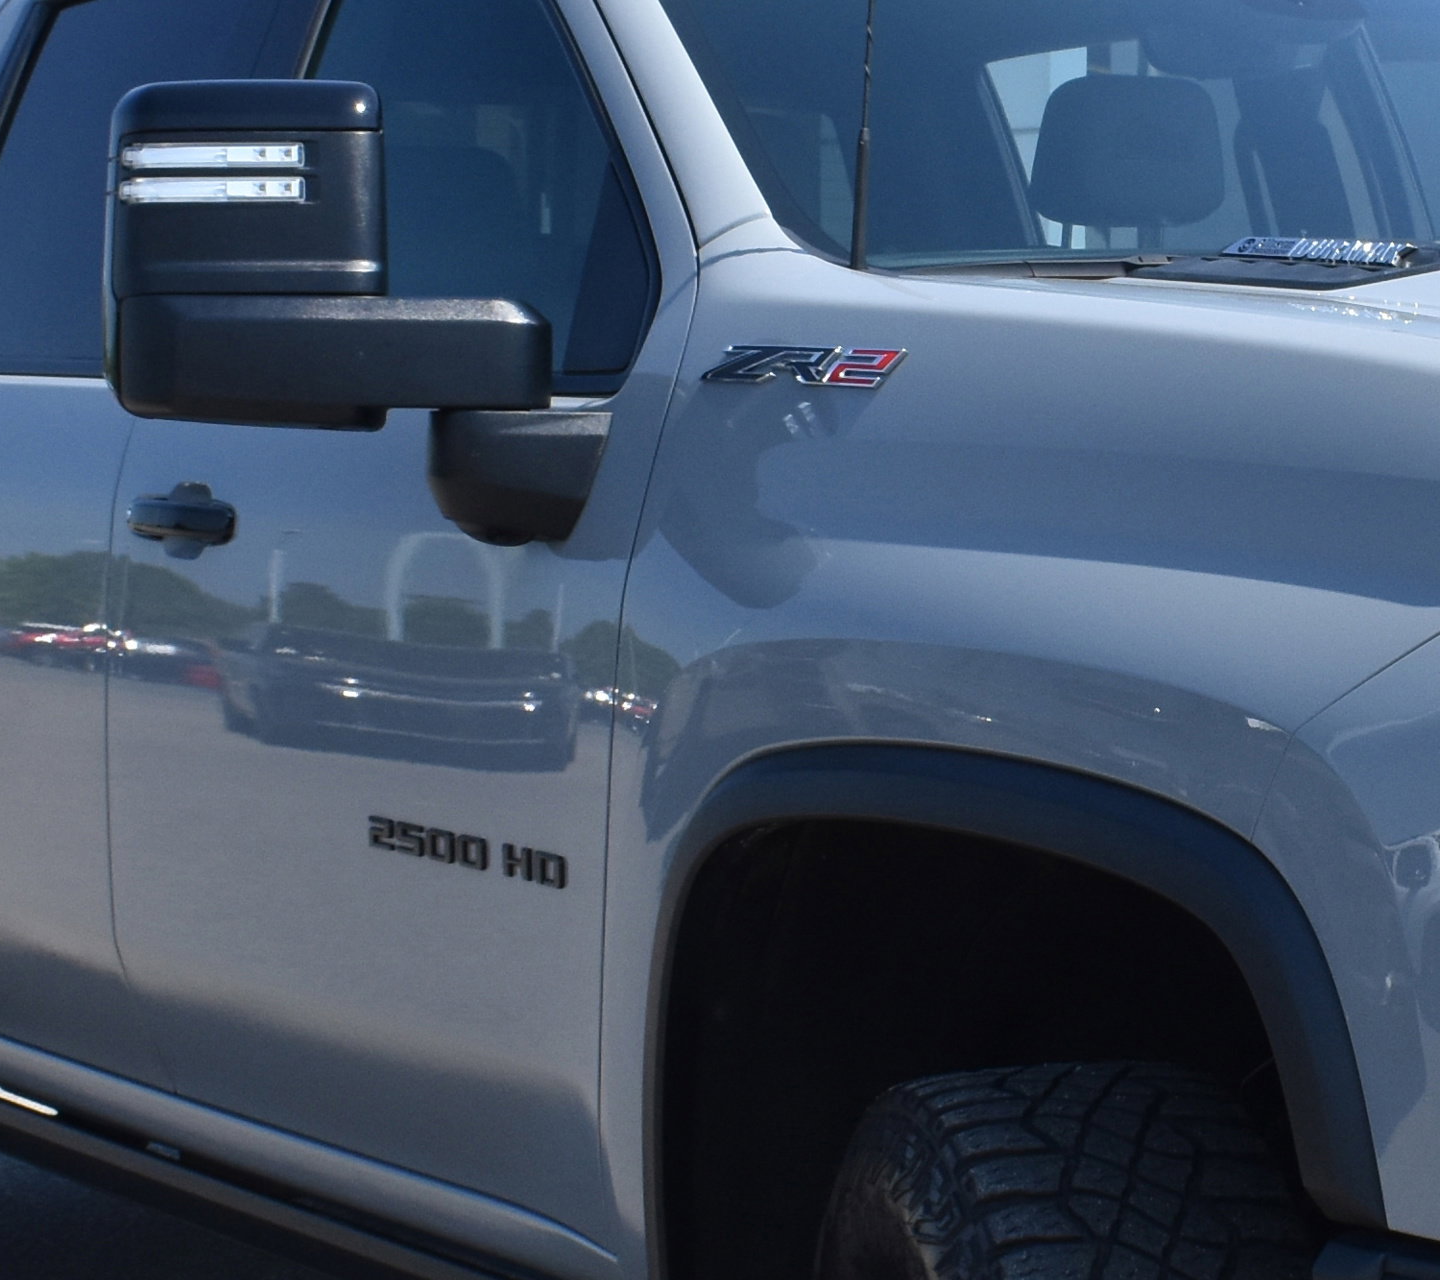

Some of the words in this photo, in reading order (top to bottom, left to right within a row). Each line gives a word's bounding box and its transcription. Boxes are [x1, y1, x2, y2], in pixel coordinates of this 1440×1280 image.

[700, 345, 908, 390] ZR2
[368, 815, 489, 871] 2500
[501, 842, 569, 890] HD
